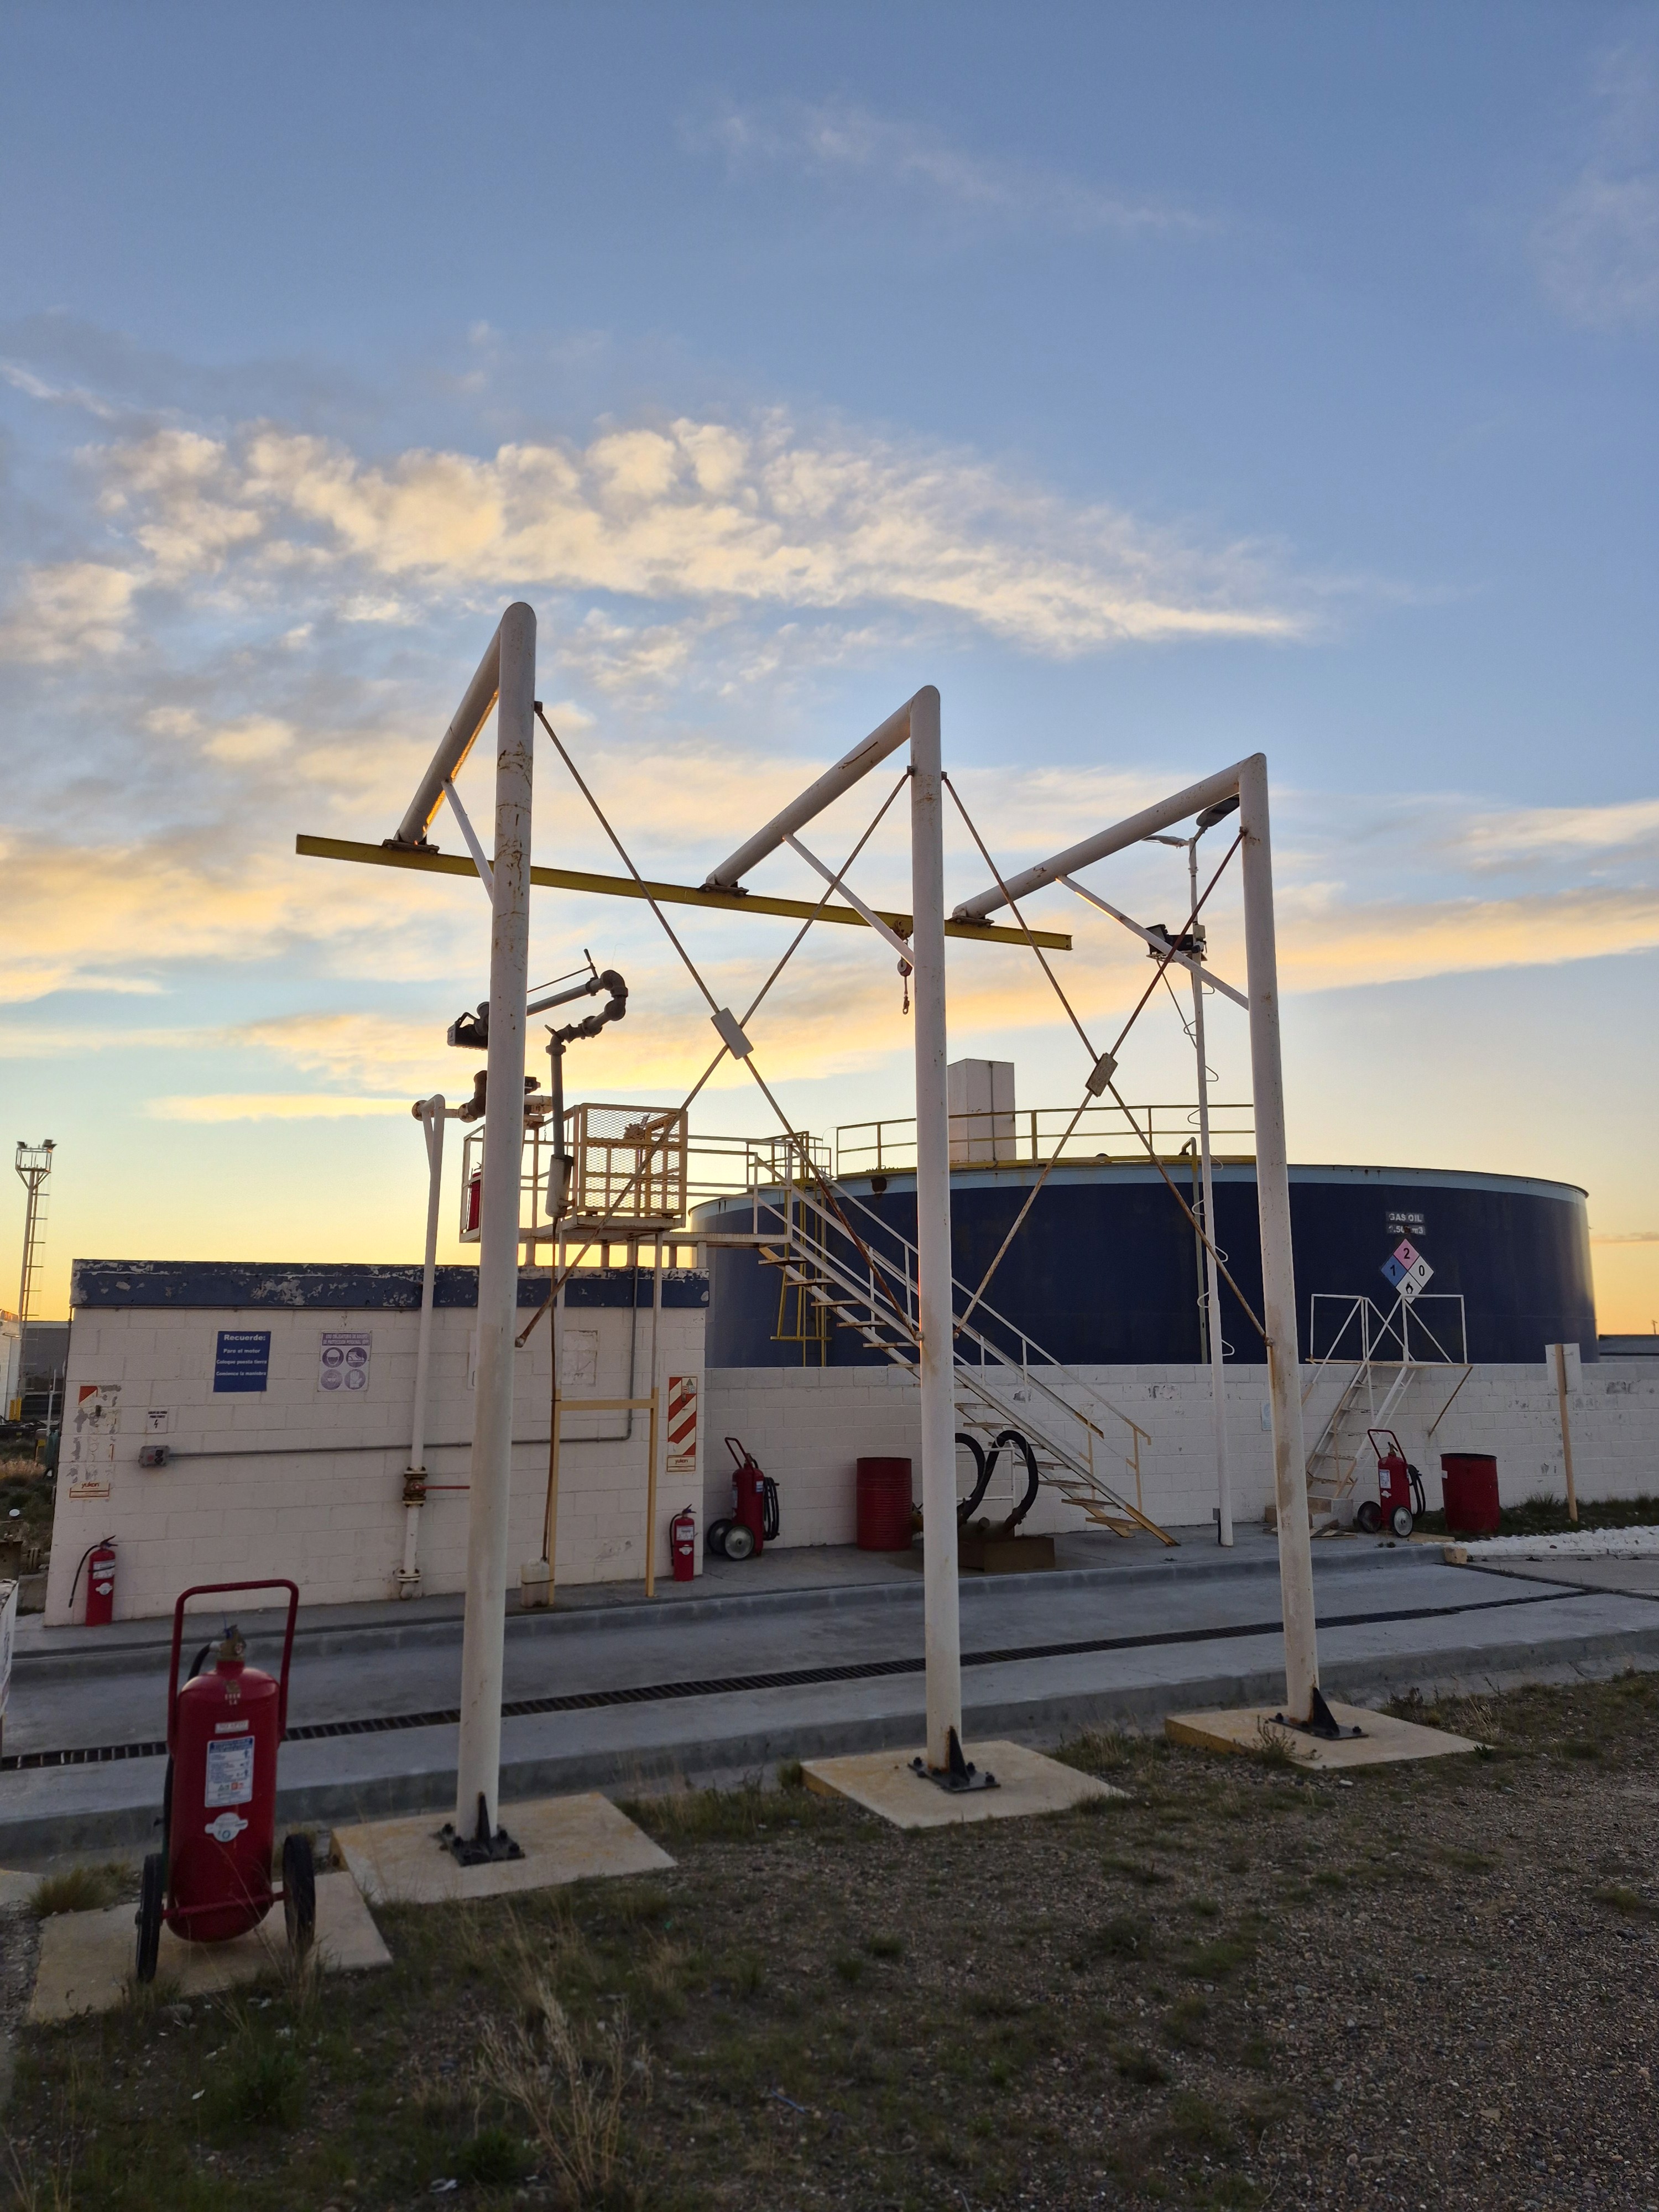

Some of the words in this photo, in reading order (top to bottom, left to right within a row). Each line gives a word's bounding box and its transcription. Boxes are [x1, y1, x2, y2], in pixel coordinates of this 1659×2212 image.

[1389, 1213, 1406, 1221] GAS
[1403, 1248, 1410, 1259] 2
[1390, 1264, 1396, 1276] 1
[1418, 1265, 1425, 1277] 0
